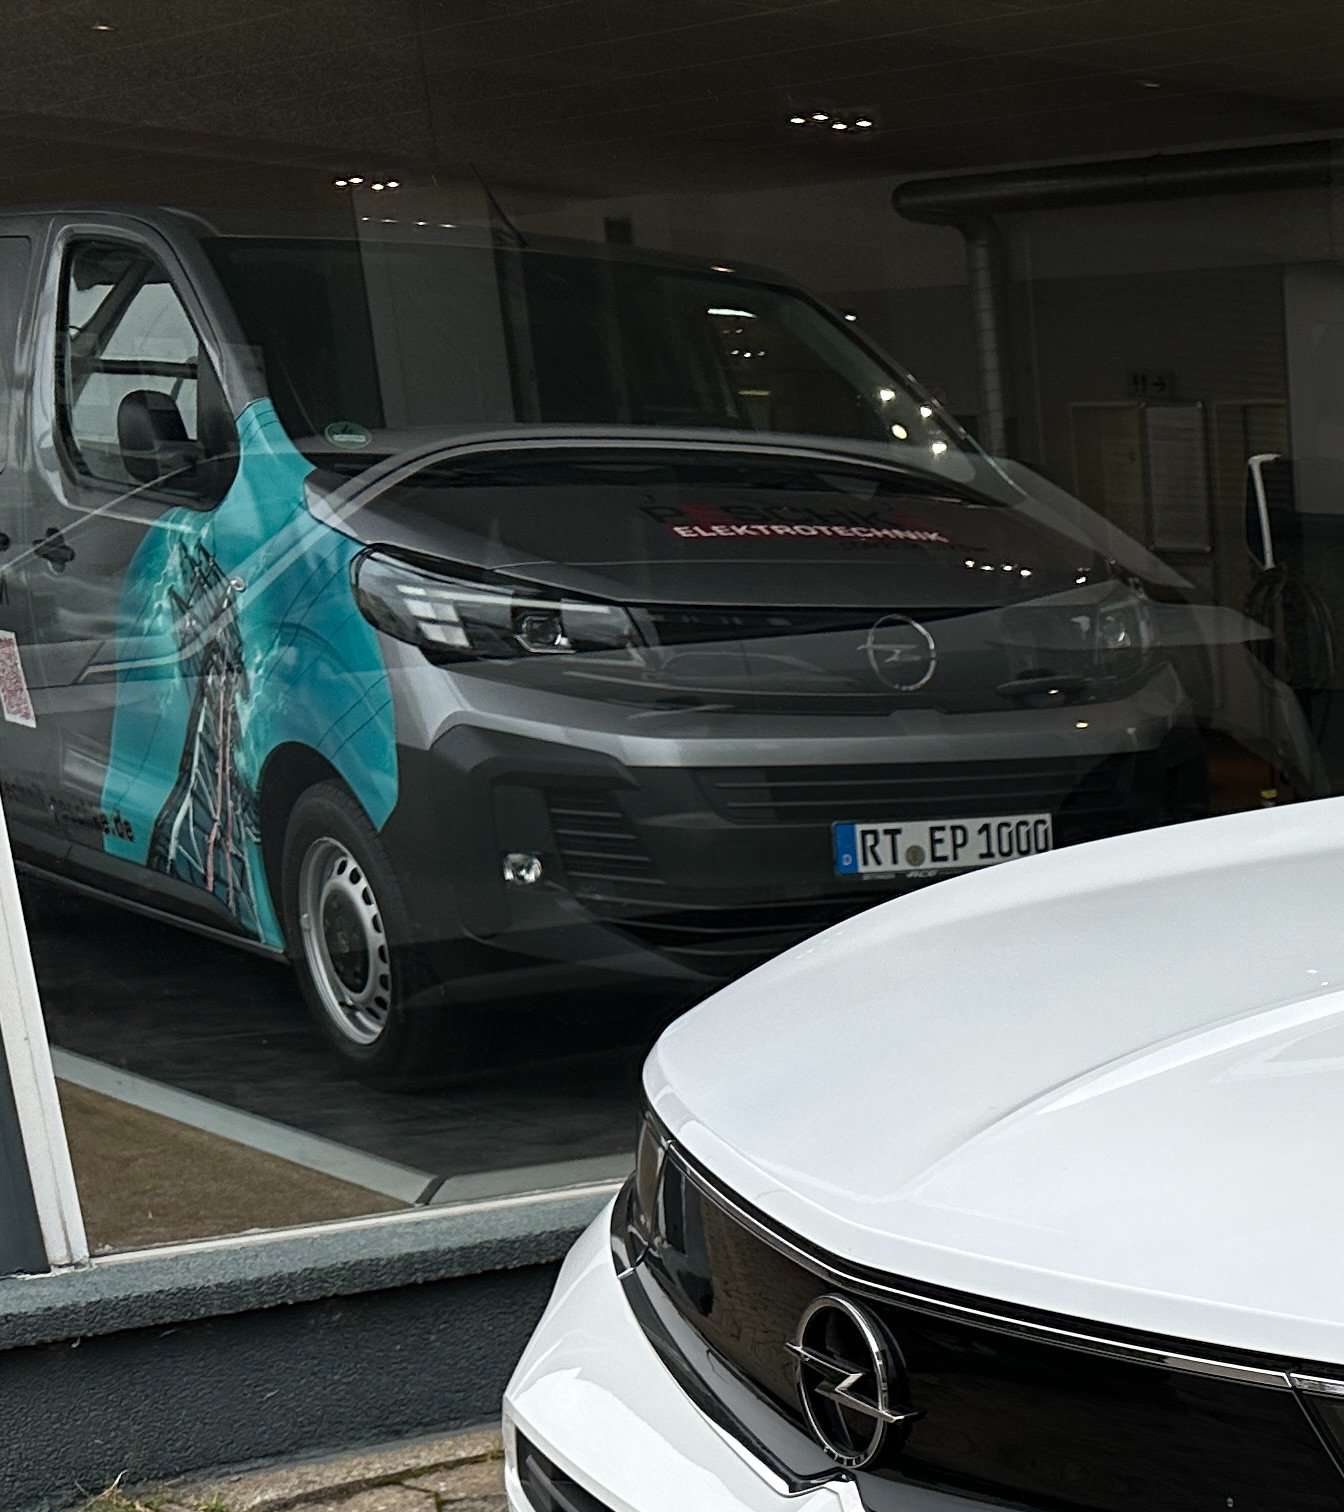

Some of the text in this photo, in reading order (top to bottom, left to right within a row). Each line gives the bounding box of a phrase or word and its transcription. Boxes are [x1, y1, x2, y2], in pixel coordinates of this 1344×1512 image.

[672, 524, 950, 543] ELEKTROTECHNIK
[860, 828, 902, 867] RT
[929, 825, 969, 863] EP
[978, 819, 1049, 860] 1000
